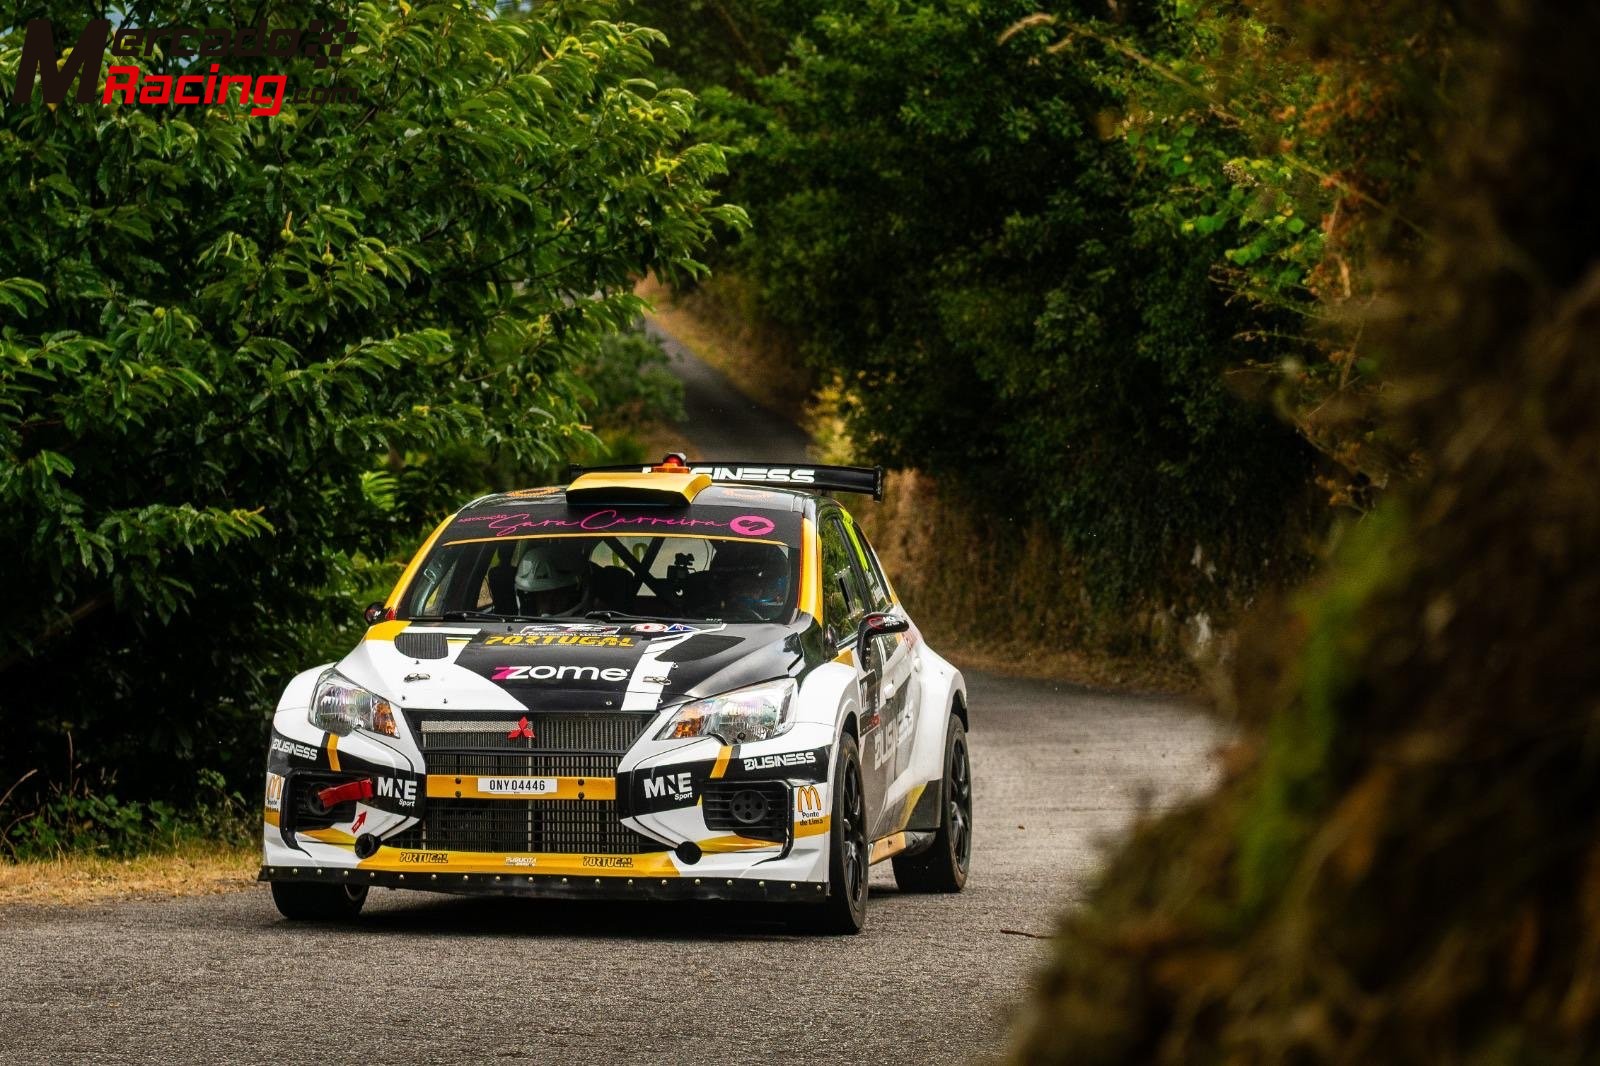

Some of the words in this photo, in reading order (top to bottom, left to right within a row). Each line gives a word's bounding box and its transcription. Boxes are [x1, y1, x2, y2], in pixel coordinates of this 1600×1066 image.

[488, 513, 580, 537] Sara
[580, 510, 730, 531] Carreira
[744, 751, 816, 771] BUSINESS
[377, 776, 418, 801] MNE
[643, 772, 693, 799] MNE
[674, 792, 693, 801] Sport
[398, 799, 415, 807] Sport
